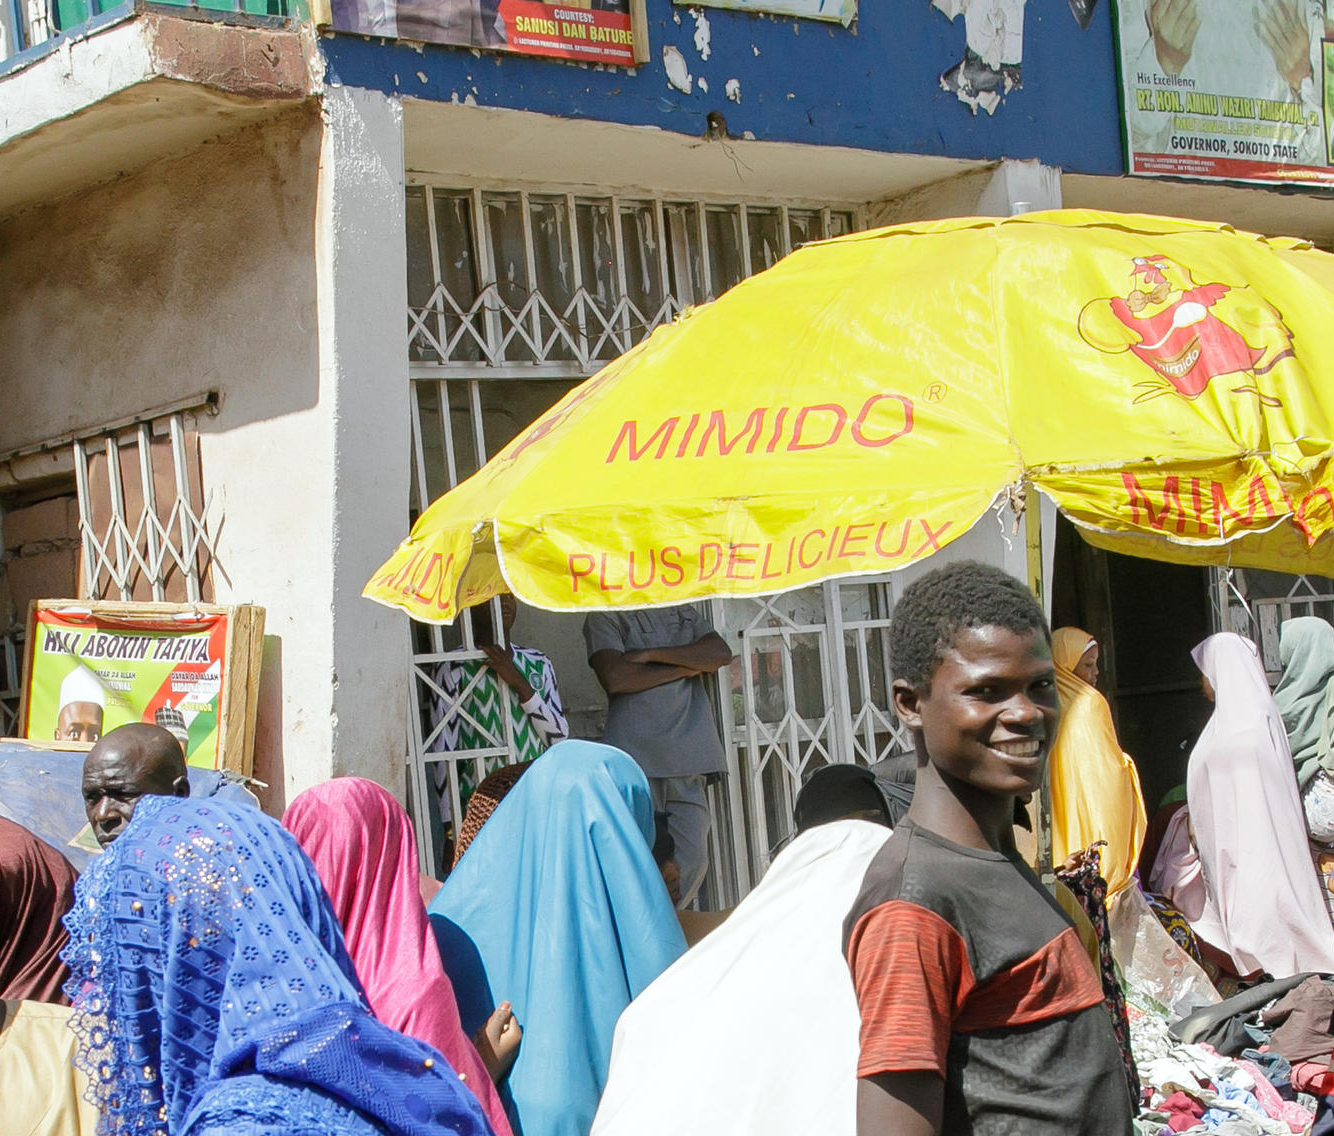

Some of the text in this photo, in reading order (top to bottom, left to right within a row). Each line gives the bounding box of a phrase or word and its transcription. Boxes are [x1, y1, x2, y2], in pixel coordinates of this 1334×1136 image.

[515, 16, 633, 45] SANUSI DAN BATURE
[554, 9, 595, 23] COURTESY:
[1137, 72, 1196, 89] His Excellency
[1136, 88, 1155, 111] RT.
[1156, 89, 1184, 113] HON.
[1186, 91, 1218, 116] AMINU
[1218, 94, 1256, 119] WAZIRI
[1171, 136, 1298, 159] GOVERNOR, SOKOTO STATE
[605, 393, 914, 463] MIMIDO
[568, 519, 954, 592] PLUS DELICIEUX
[81, 633, 152, 660] ABOKIN
[153, 636, 211, 663] TAFIYA
